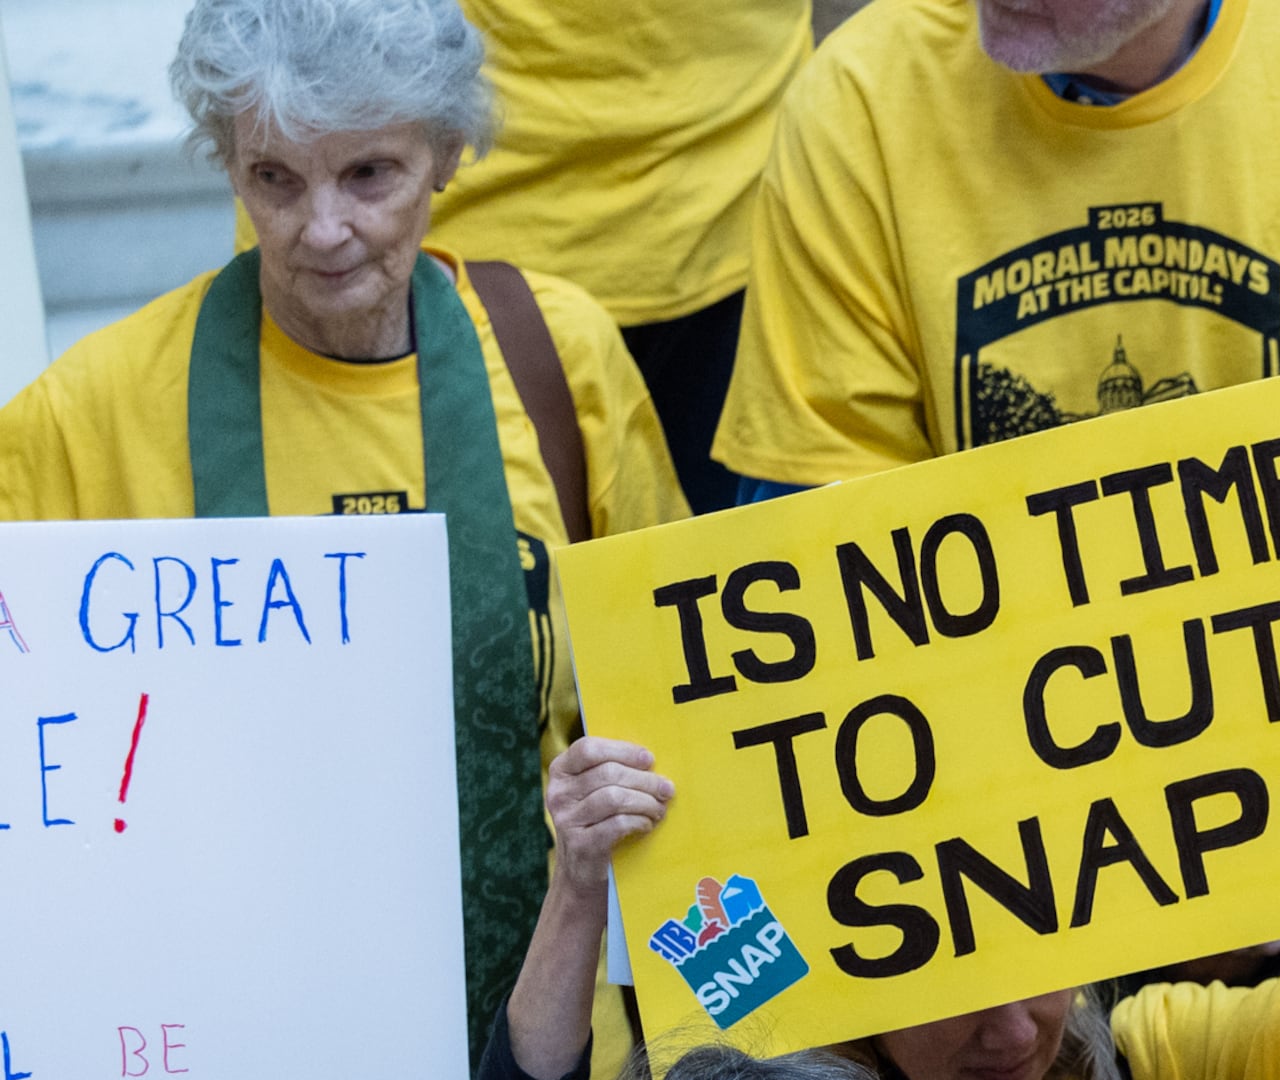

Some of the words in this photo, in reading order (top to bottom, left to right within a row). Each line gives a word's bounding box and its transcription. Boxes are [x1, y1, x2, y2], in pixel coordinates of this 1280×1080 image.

[1098, 206, 1156, 230] 2026
[972, 241, 1101, 310] MORAL
[1104, 234, 1270, 294] MONDAYS
[1016, 282, 1055, 320] AT
[1055, 272, 1111, 306] THE
[1113, 267, 1224, 305] CAPITOL:
[343, 495, 401, 515] 2026
[78, 551, 367, 653] GREAT
[653, 560, 817, 704] IS
[835, 513, 999, 662] NO
[0, 693, 149, 833] E!
[732, 693, 936, 838] TO
[826, 767, 1270, 979] SNAP
[696, 921, 785, 1015] SNAP
[117, 1023, 190, 1077] BE
